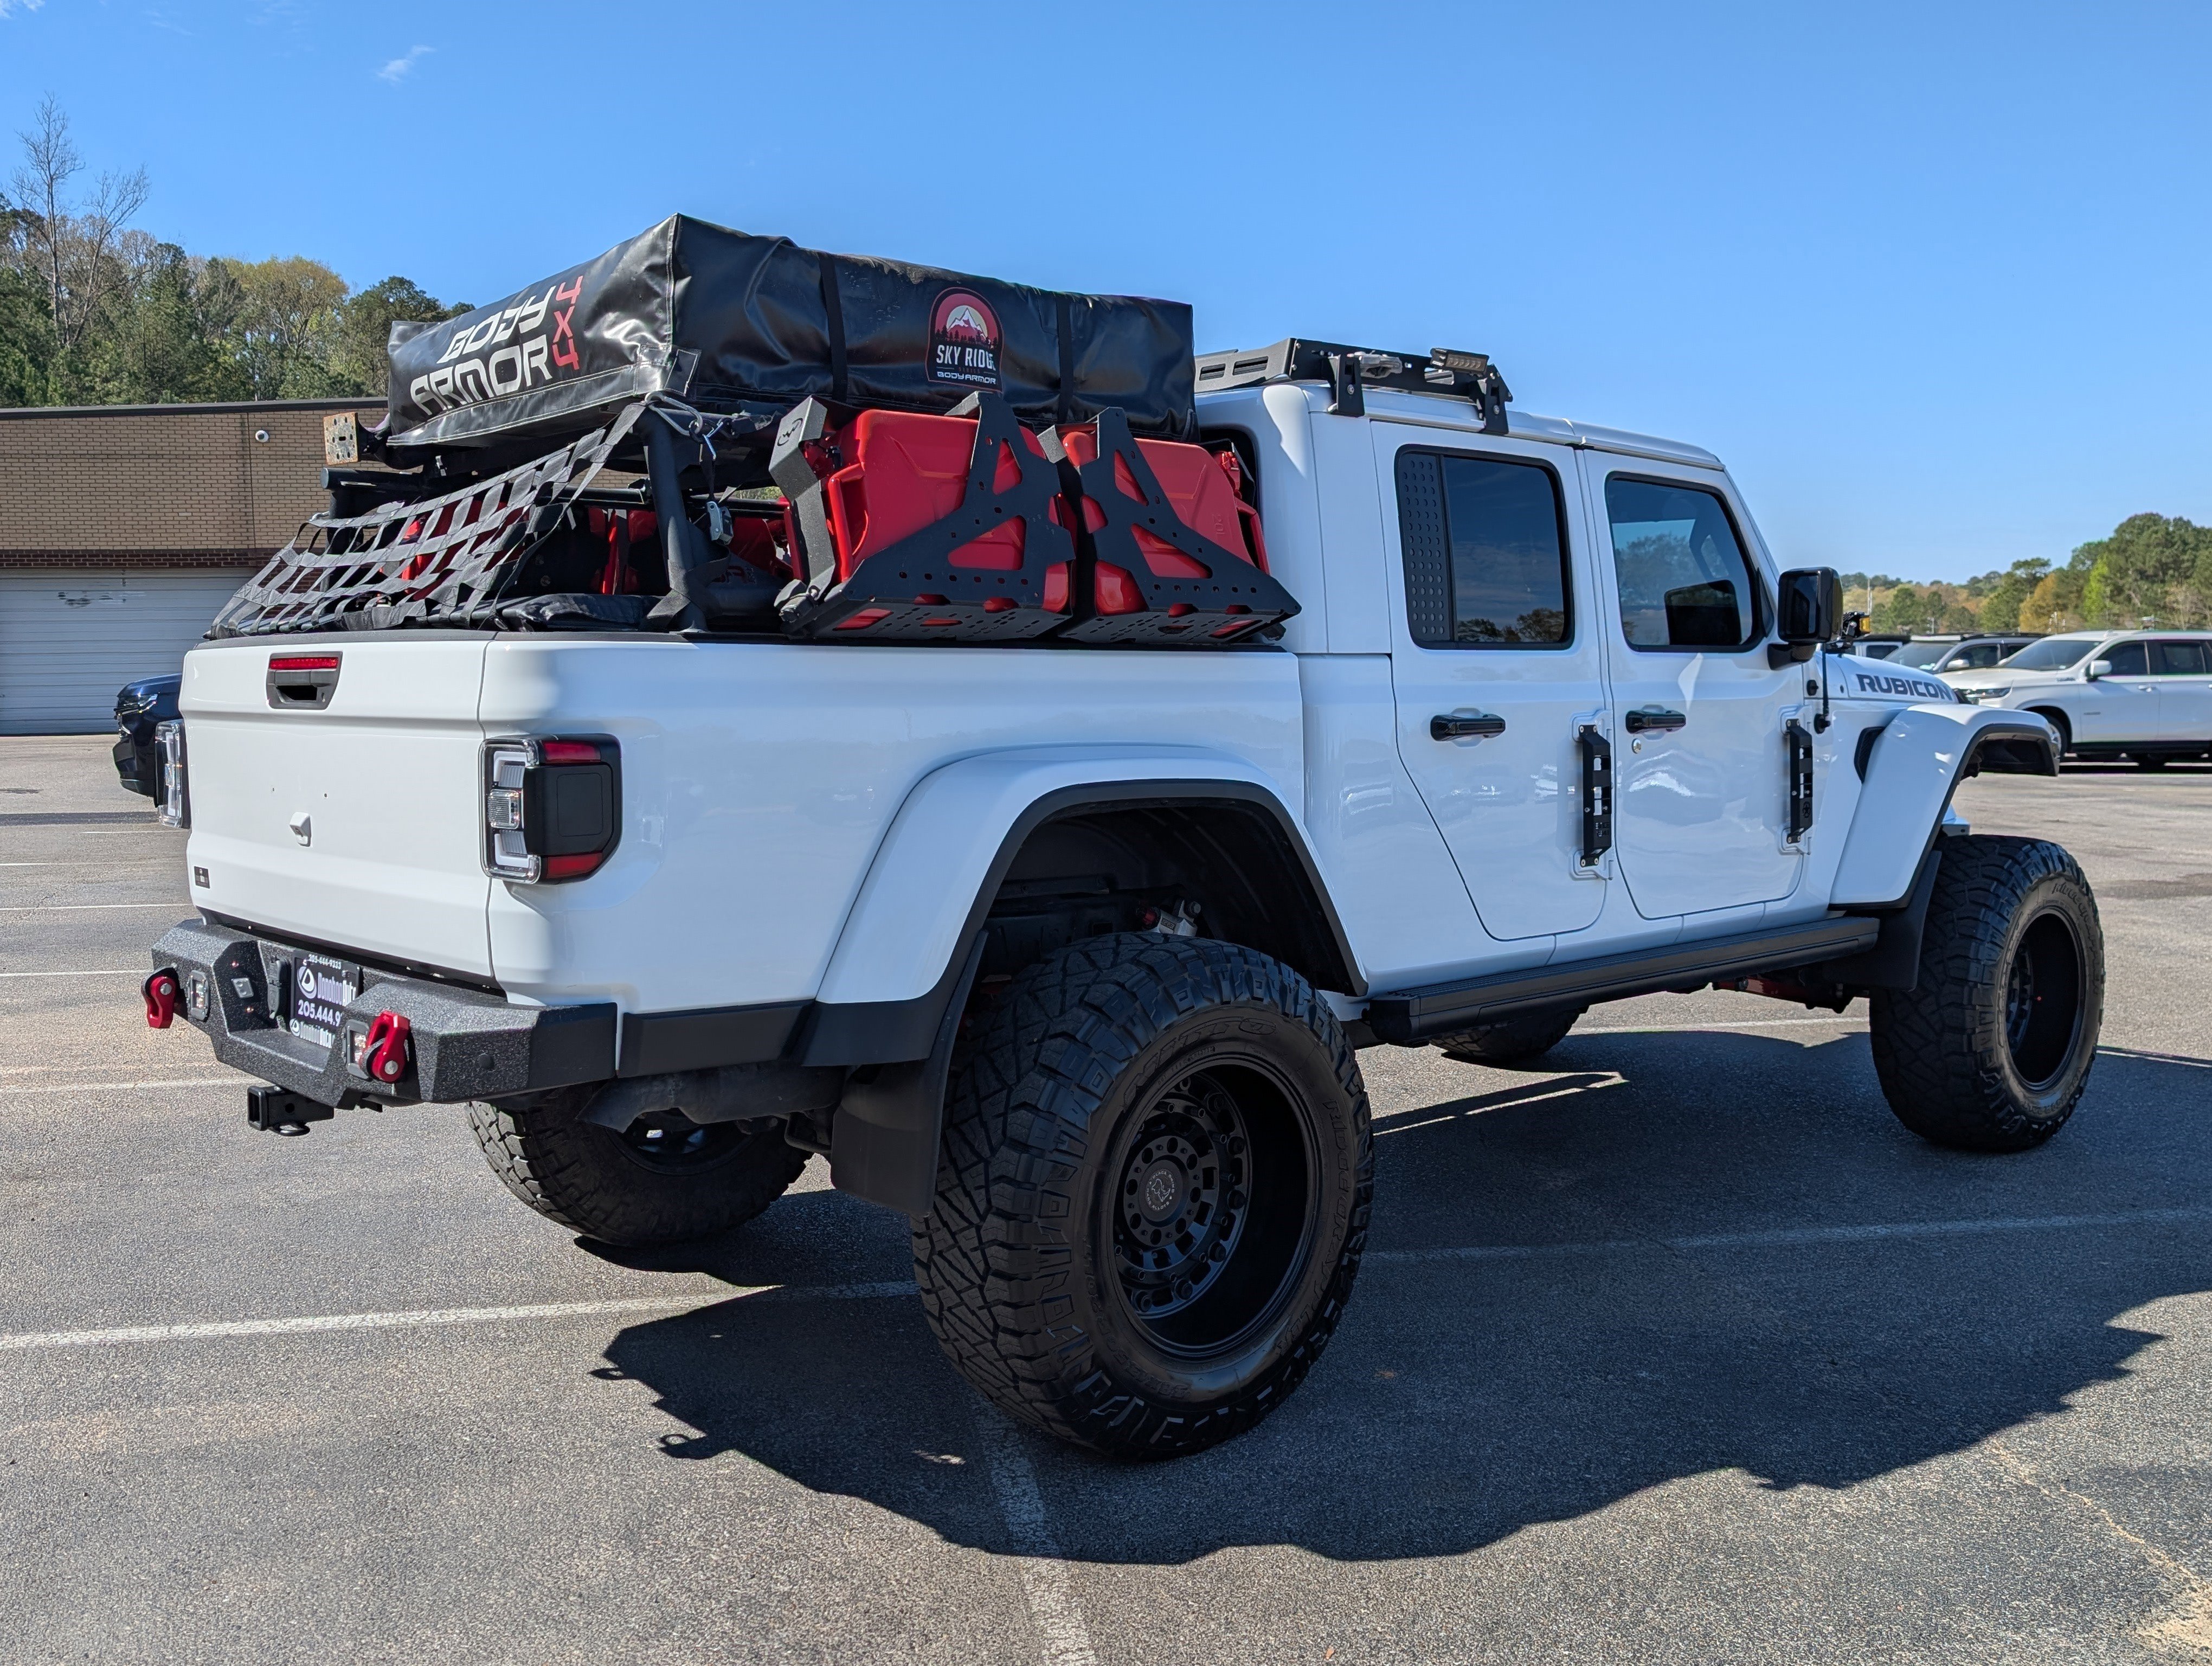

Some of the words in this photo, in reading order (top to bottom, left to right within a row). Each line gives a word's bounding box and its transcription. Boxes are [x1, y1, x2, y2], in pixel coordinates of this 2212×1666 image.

[436, 286, 557, 364] BODY
[936, 344, 962, 365] SKY
[410, 335, 553, 415] ARMOR
[1856, 674, 1953, 701] RUBICON
[298, 999, 344, 1027] 205.444.9
